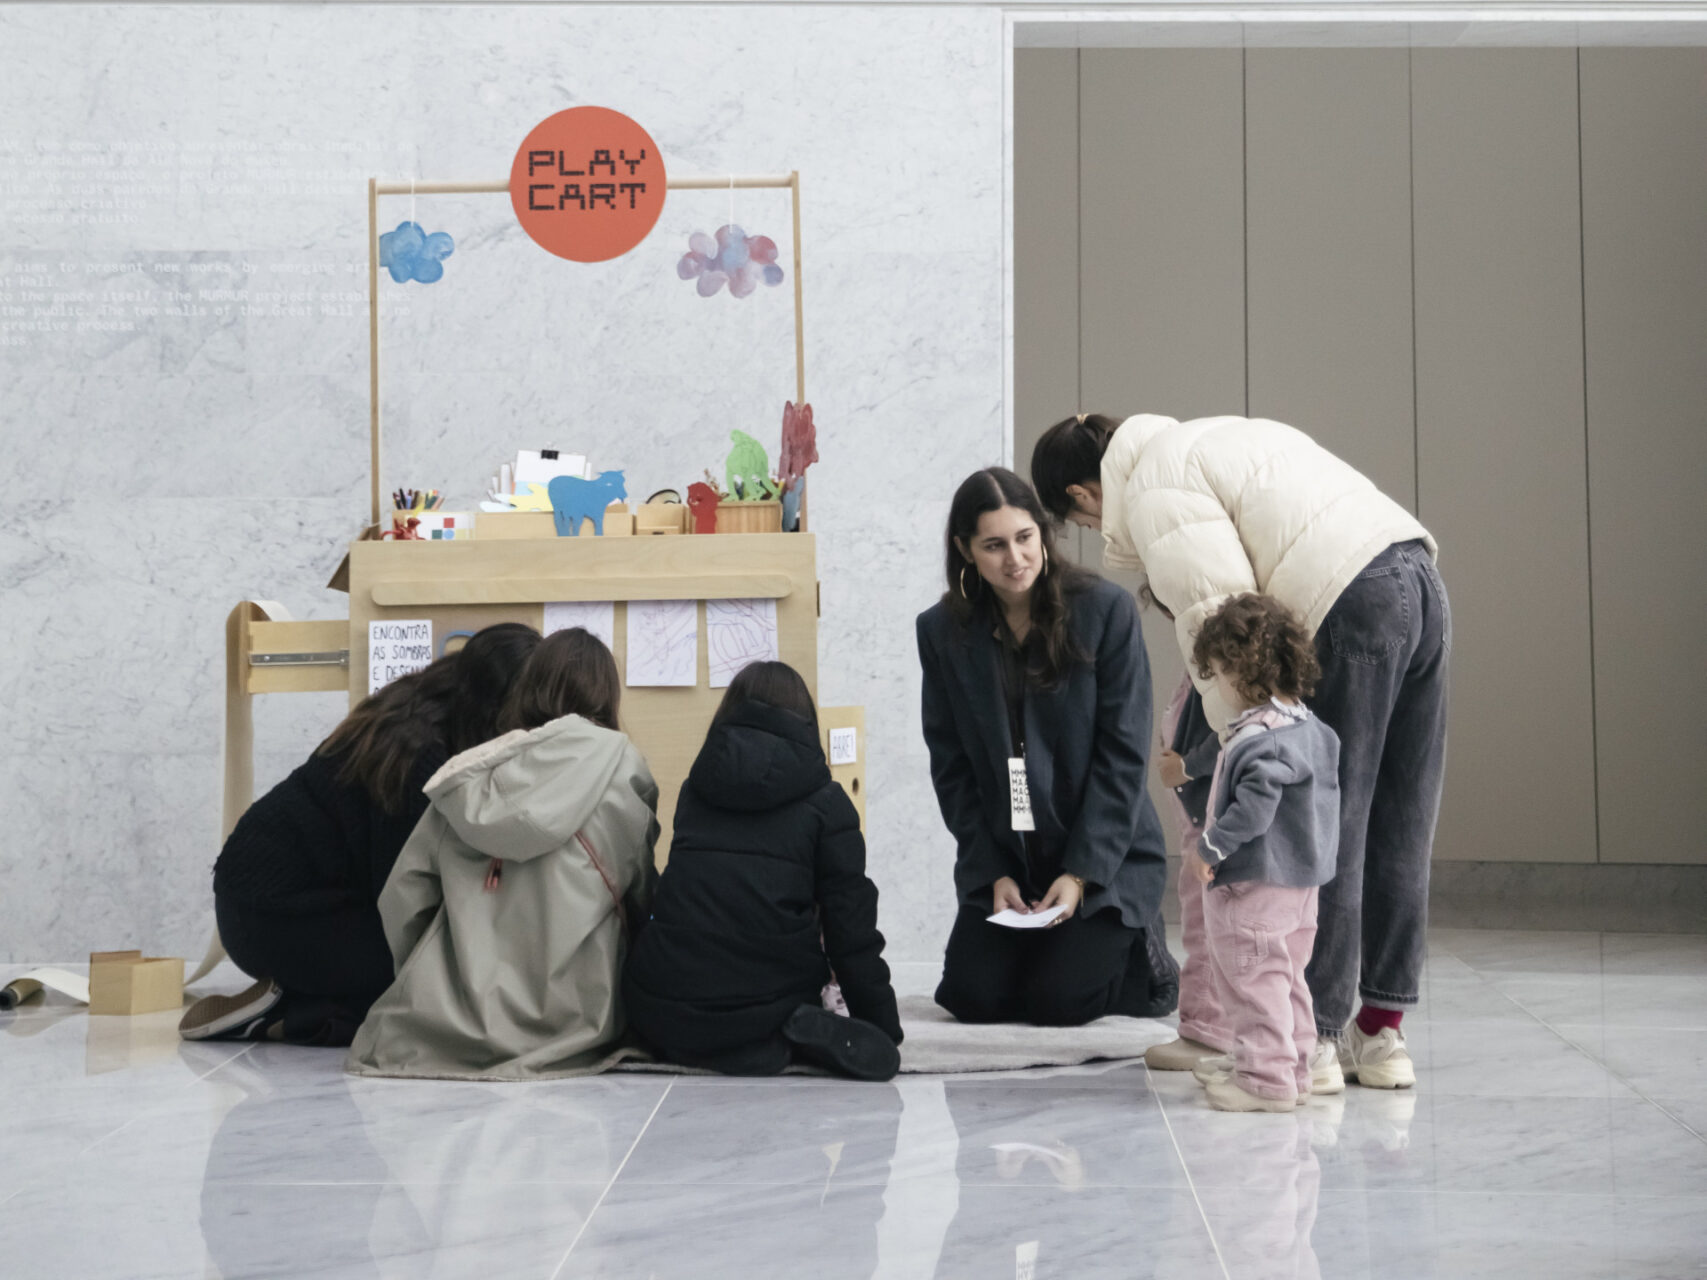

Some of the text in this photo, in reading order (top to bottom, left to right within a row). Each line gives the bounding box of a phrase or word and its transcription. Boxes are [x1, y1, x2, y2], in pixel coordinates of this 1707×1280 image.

[528, 149, 645, 176] PLAY
[528, 183, 645, 210] CART
[15, 262, 47, 272] aims
[60, 262, 76, 272] to
[86, 262, 144, 274] present
[154, 263, 180, 272] new
[189, 262, 231, 272] works
[241, 261, 258, 273] by
[270, 263, 336, 275] emerging
[22, 291, 45, 302] the
[54, 292, 94, 303] space
[168, 291, 191, 302] the
[199, 291, 248, 302] MURMUR
[256, 291, 312, 304] project
[2, 305, 26, 315] the
[33, 305, 90, 318] public.
[97, 305, 124, 315] The
[135, 305, 158, 315] two
[165, 304, 206, 316] walls
[214, 305, 231, 315] of
[241, 305, 264, 315] the
[271, 305, 312, 315] Great
[320, 305, 352, 315] Hall
[1, 320, 141, 334] creative process.
[373, 624, 429, 640] ENCONTRA
[373, 645, 431, 661] AS SOMBRAS
[373, 667, 380, 681] E
